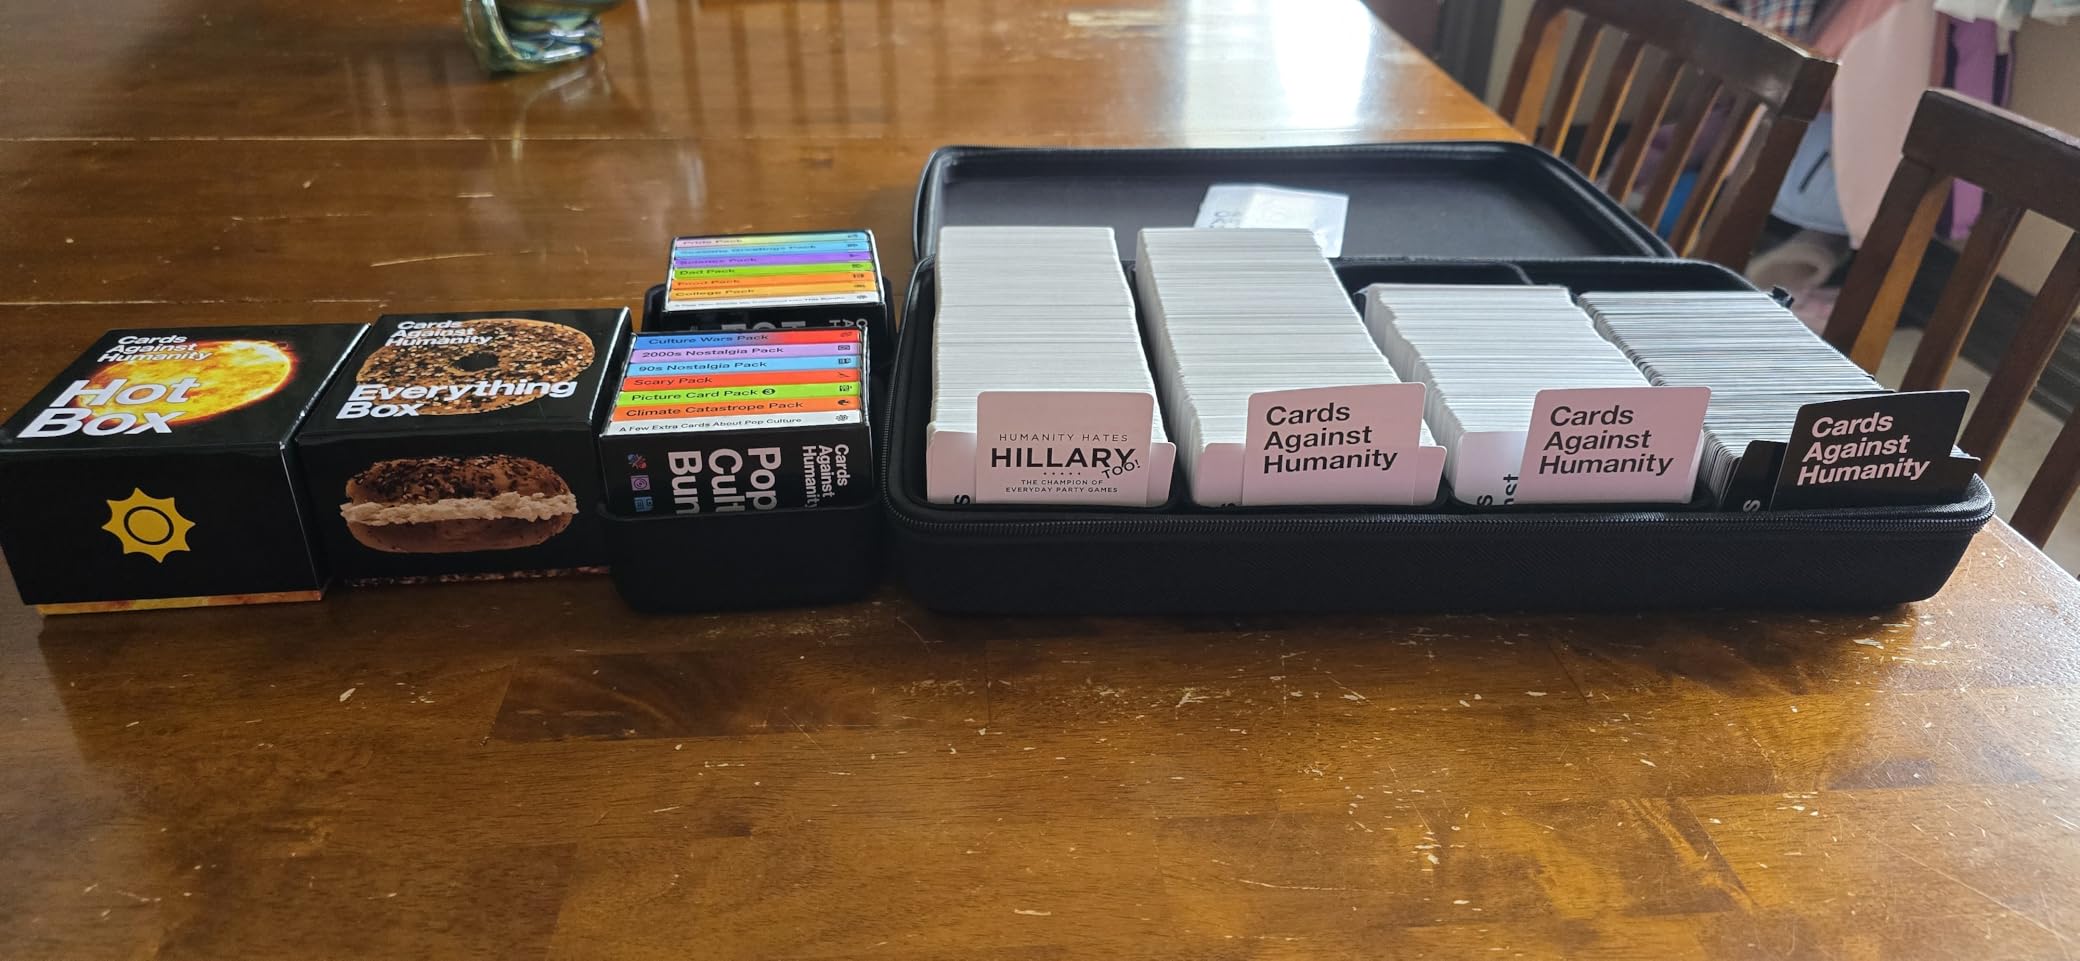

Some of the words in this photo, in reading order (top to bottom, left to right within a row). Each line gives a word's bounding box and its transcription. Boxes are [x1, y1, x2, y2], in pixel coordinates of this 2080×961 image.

[390, 327, 476, 338] Against
[398, 320, 463, 330] Cards
[106, 343, 198, 355] Against
[118, 335, 188, 345] Cards
[384, 335, 494, 347] Humanity
[97, 351, 213, 363] Humanity
[666, 363, 730, 371] Nostalgia
[49, 377, 202, 407] Hot
[348, 379, 578, 402] Everything
[335, 401, 425, 419] Box
[626, 408, 681, 417] Climate
[1266, 402, 1351, 426] Cards
[1550, 405, 1635, 427] Cards
[16, 407, 187, 438] Box
[1811, 411, 1894, 438] Cards
[999, 433, 1075, 442] HUMANITY
[1082, 433, 1129, 442] HATES
[1263, 425, 1373, 453] Against
[1543, 429, 1652, 455] Against
[991, 447, 1136, 468] HILLARY
[1802, 434, 1910, 465] Against
[816, 445, 835, 498] Against
[835, 444, 851, 487] Cards
[1102, 459, 1141, 479] TOO!
[1263, 449, 1398, 474] Humanity
[1538, 454, 1674, 477] Humanity
[1797, 458, 1930, 486] Humanity
[668, 450, 703, 515] Bun
[708, 448, 746, 513] Cult
[746, 447, 782, 510] Pop
